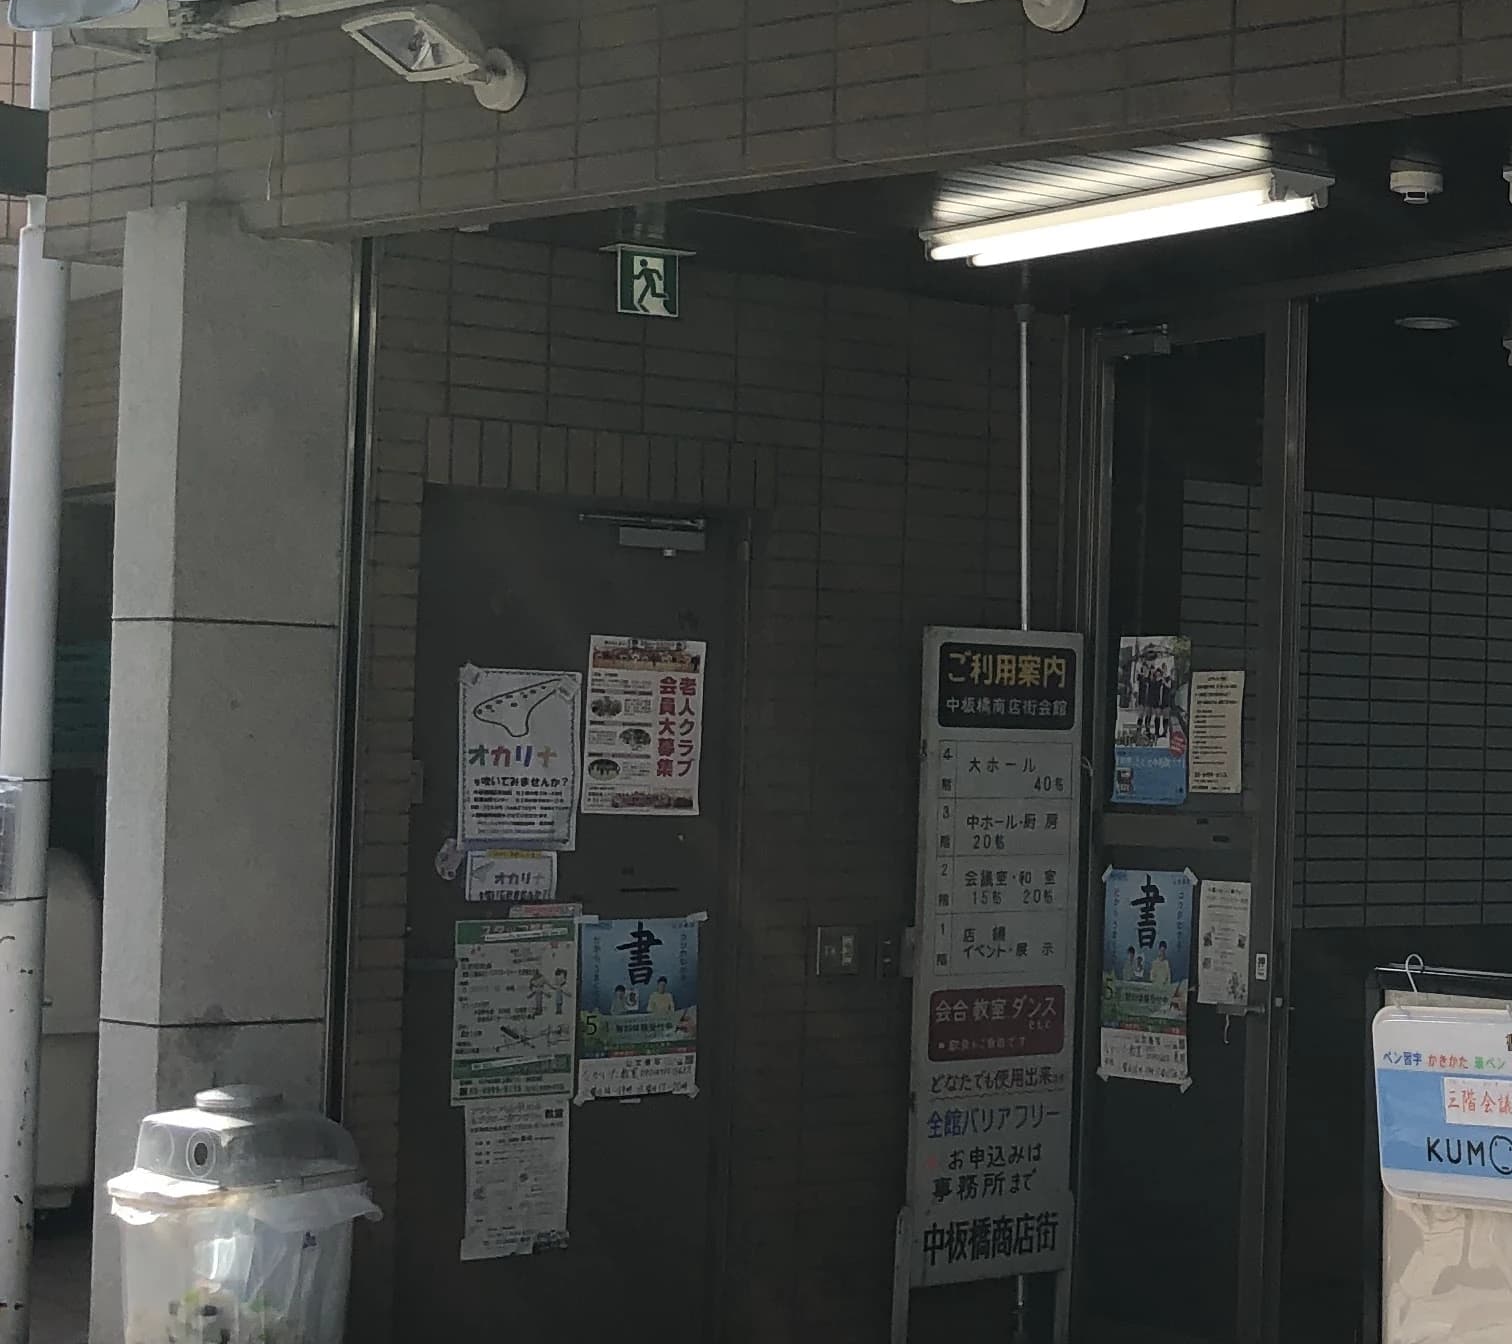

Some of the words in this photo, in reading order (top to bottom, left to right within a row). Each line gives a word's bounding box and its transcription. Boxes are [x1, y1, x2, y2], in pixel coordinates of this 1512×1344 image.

[946, 650, 1068, 689] ご利用案内
[945, 697, 1068, 717] 中板橋商店街会館
[656, 675, 678, 778] 会員大募集
[677, 676, 697, 777] 老人クラブ
[467, 744, 558, 768] オカリナ
[968, 756, 1037, 775] 大ホール
[1131, 873, 1166, 949] 書
[615, 921, 664, 986] 書
[935, 999, 969, 1023] 会合
[972, 997, 1008, 1023] 教室
[1011, 994, 1058, 1020] ダンス
[1382, 1051, 1423, 1066] ペン習字
[1426, 1054, 1470, 1070] かきかた
[927, 1104, 1061, 1139] 全館バリアフリー
[948, 1143, 1042, 1170] お申込みは
[933, 1168, 1037, 1202] 事務所まで
[922, 1212, 1060, 1267] 中板橋商店街
